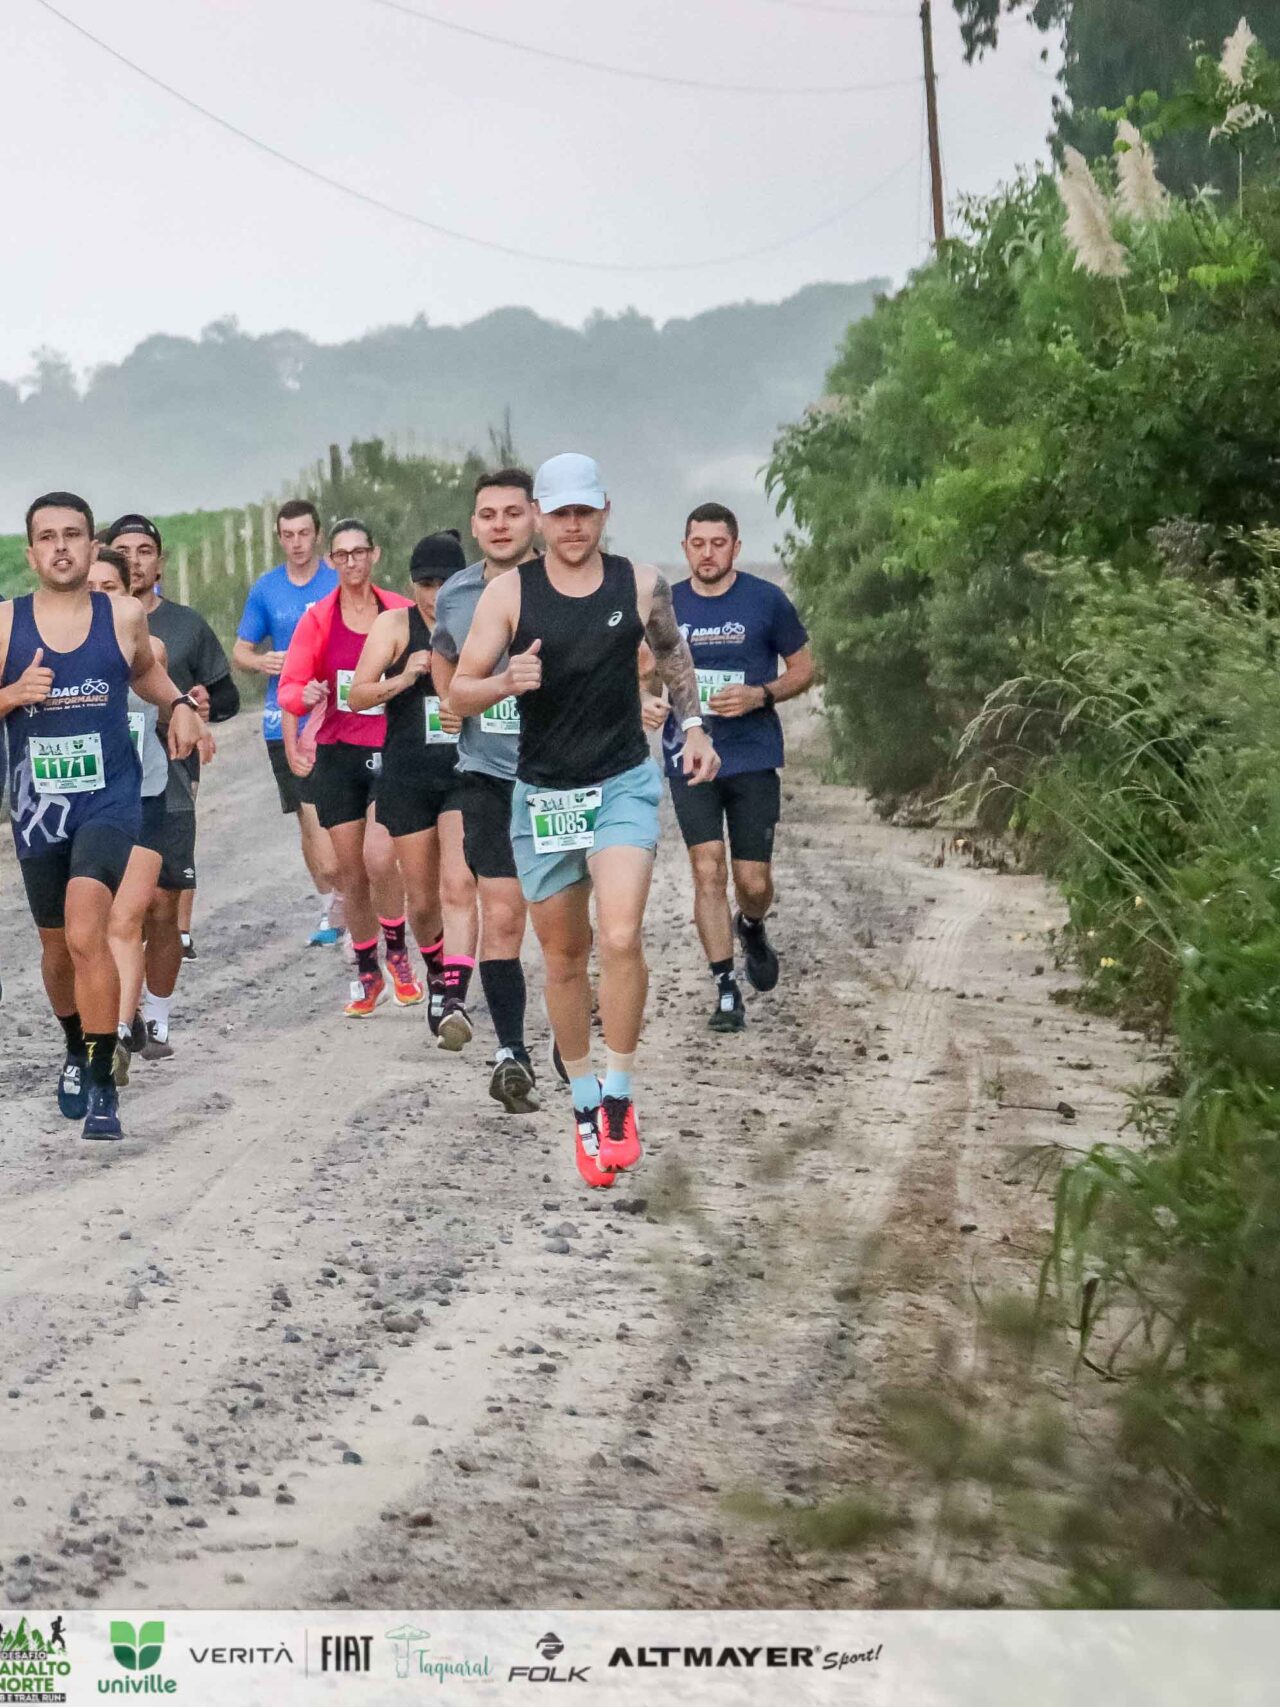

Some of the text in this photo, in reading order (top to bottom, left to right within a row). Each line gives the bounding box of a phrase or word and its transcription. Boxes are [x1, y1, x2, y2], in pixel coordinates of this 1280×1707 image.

[691, 627, 721, 636] ADAG
[493, 699, 520, 719] 108
[41, 756, 86, 778] 1171
[544, 811, 587, 836] 1085
